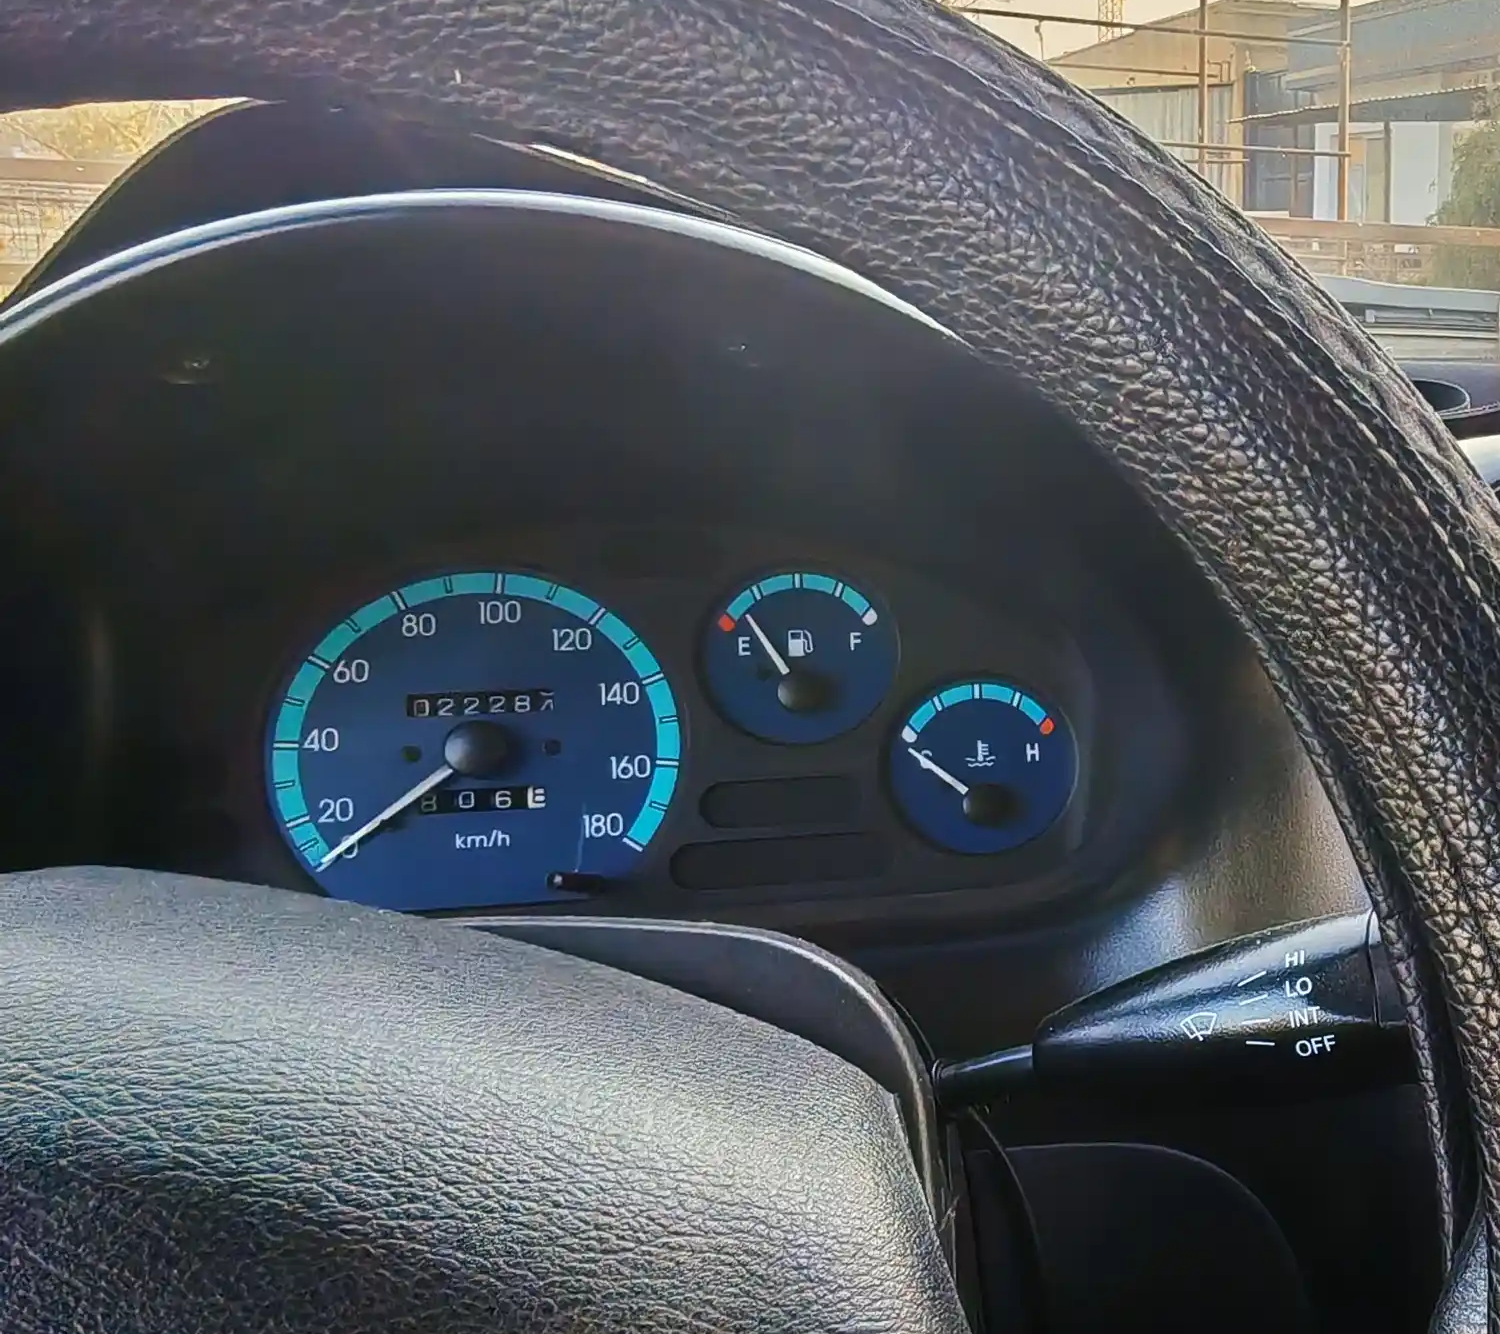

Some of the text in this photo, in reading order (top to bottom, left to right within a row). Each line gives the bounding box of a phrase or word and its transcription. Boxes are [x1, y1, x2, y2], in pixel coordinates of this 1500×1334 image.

[479, 601, 522, 624] 100
[402, 614, 437, 637] 80
[552, 628, 592, 651] 120
[738, 636, 752, 656] E
[850, 632, 863, 651] F
[333, 659, 370, 683] 60
[600, 682, 640, 706] 140
[302, 727, 340, 752] 40
[1026, 743, 1040, 763] H
[610, 755, 651, 780] 160
[318, 798, 354, 823] 20
[583, 812, 624, 837] 180
[455, 830, 511, 850] km/h
[1285, 950, 1305, 967] HI
[1285, 977, 1313, 998] LO
[1287, 1005, 1321, 1028] INT
[1295, 1034, 1336, 1057] OFF
